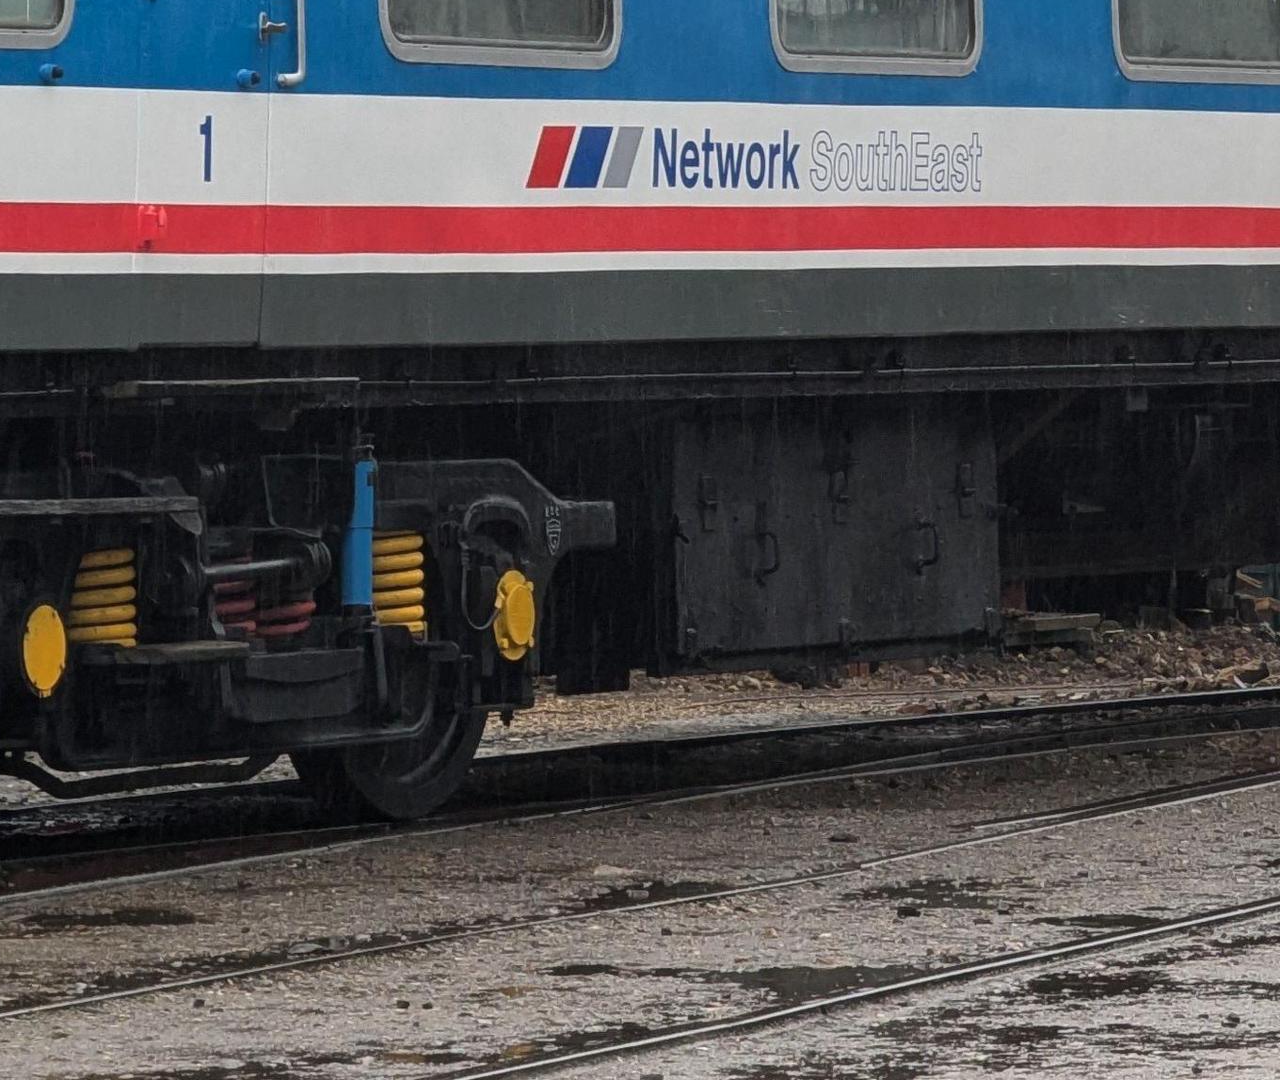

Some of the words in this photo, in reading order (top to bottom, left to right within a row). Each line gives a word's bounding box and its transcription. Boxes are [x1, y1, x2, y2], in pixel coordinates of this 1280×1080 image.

[200, 115, 212, 182] 1
[652, 127, 801, 190] Network
[809, 130, 983, 193] SouthEast
